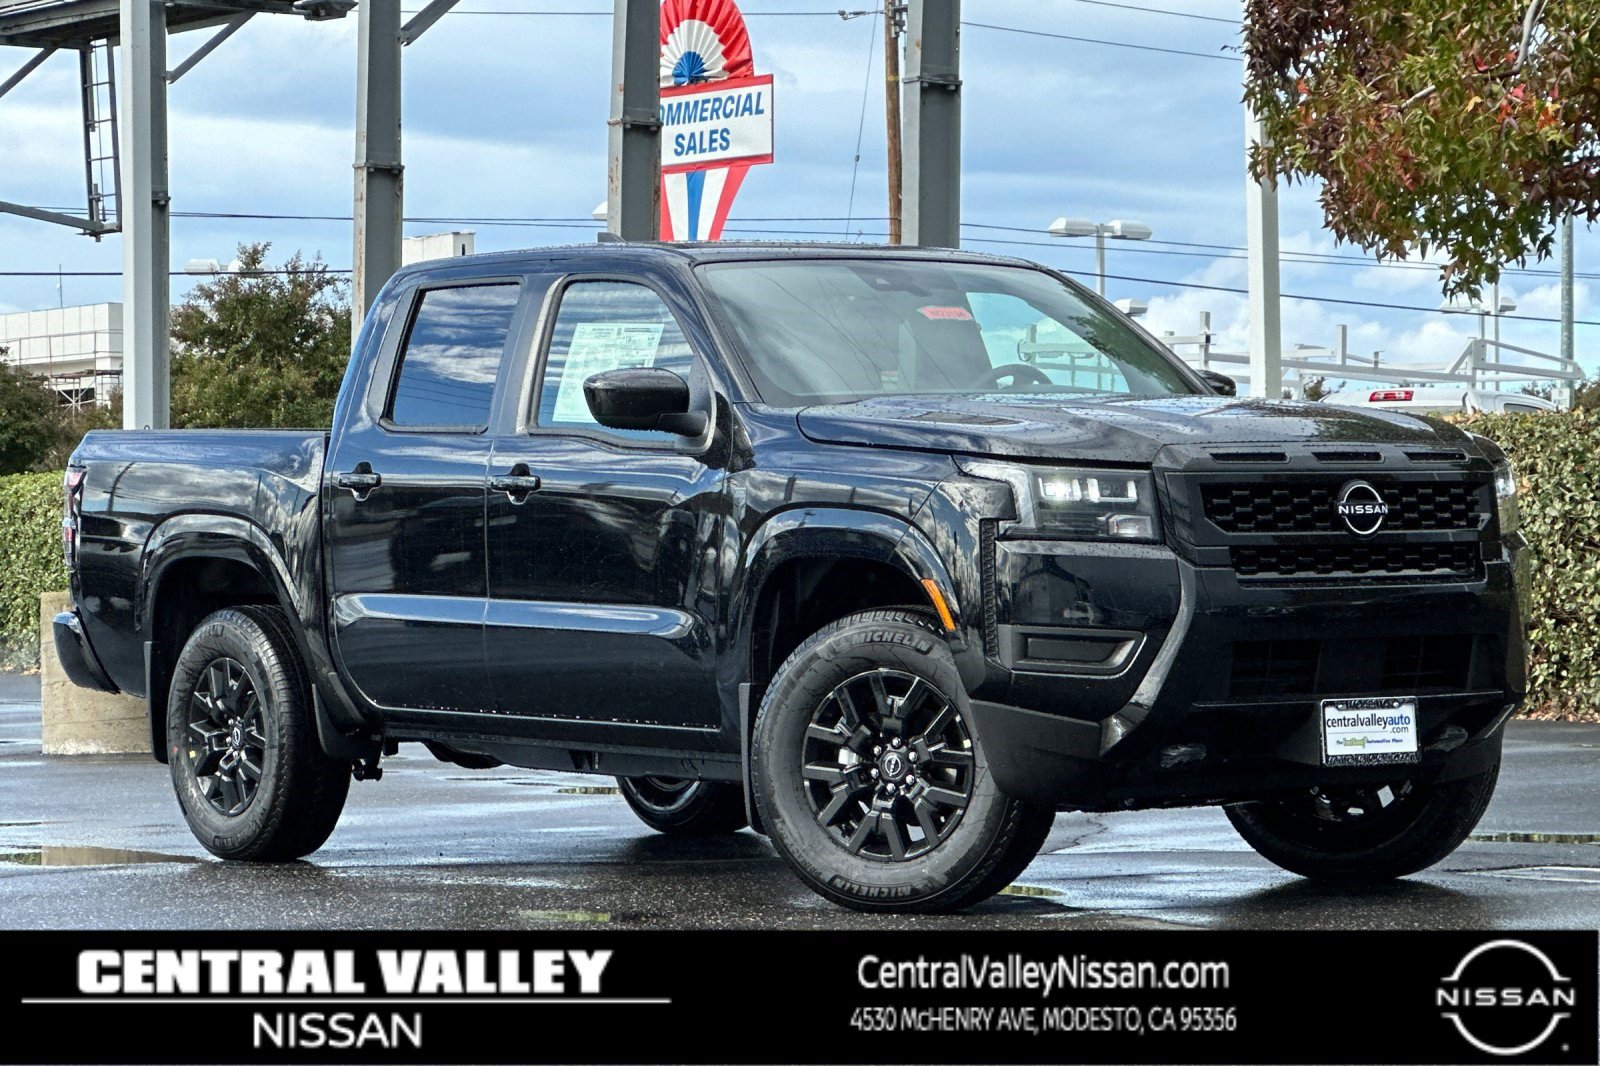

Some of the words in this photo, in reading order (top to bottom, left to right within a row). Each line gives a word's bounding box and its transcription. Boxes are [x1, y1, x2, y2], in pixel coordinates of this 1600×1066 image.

[659, 92, 765, 126] MMERCIAL
[673, 127, 731, 157] SALES
[1338, 505, 1388, 514] NISSAN
[851, 631, 933, 652] MICHELIN
[1326, 713, 1411, 729] centralvalleyauto
[1390, 726, 1409, 734] .com
[832, 877, 912, 898] MICHELIN
